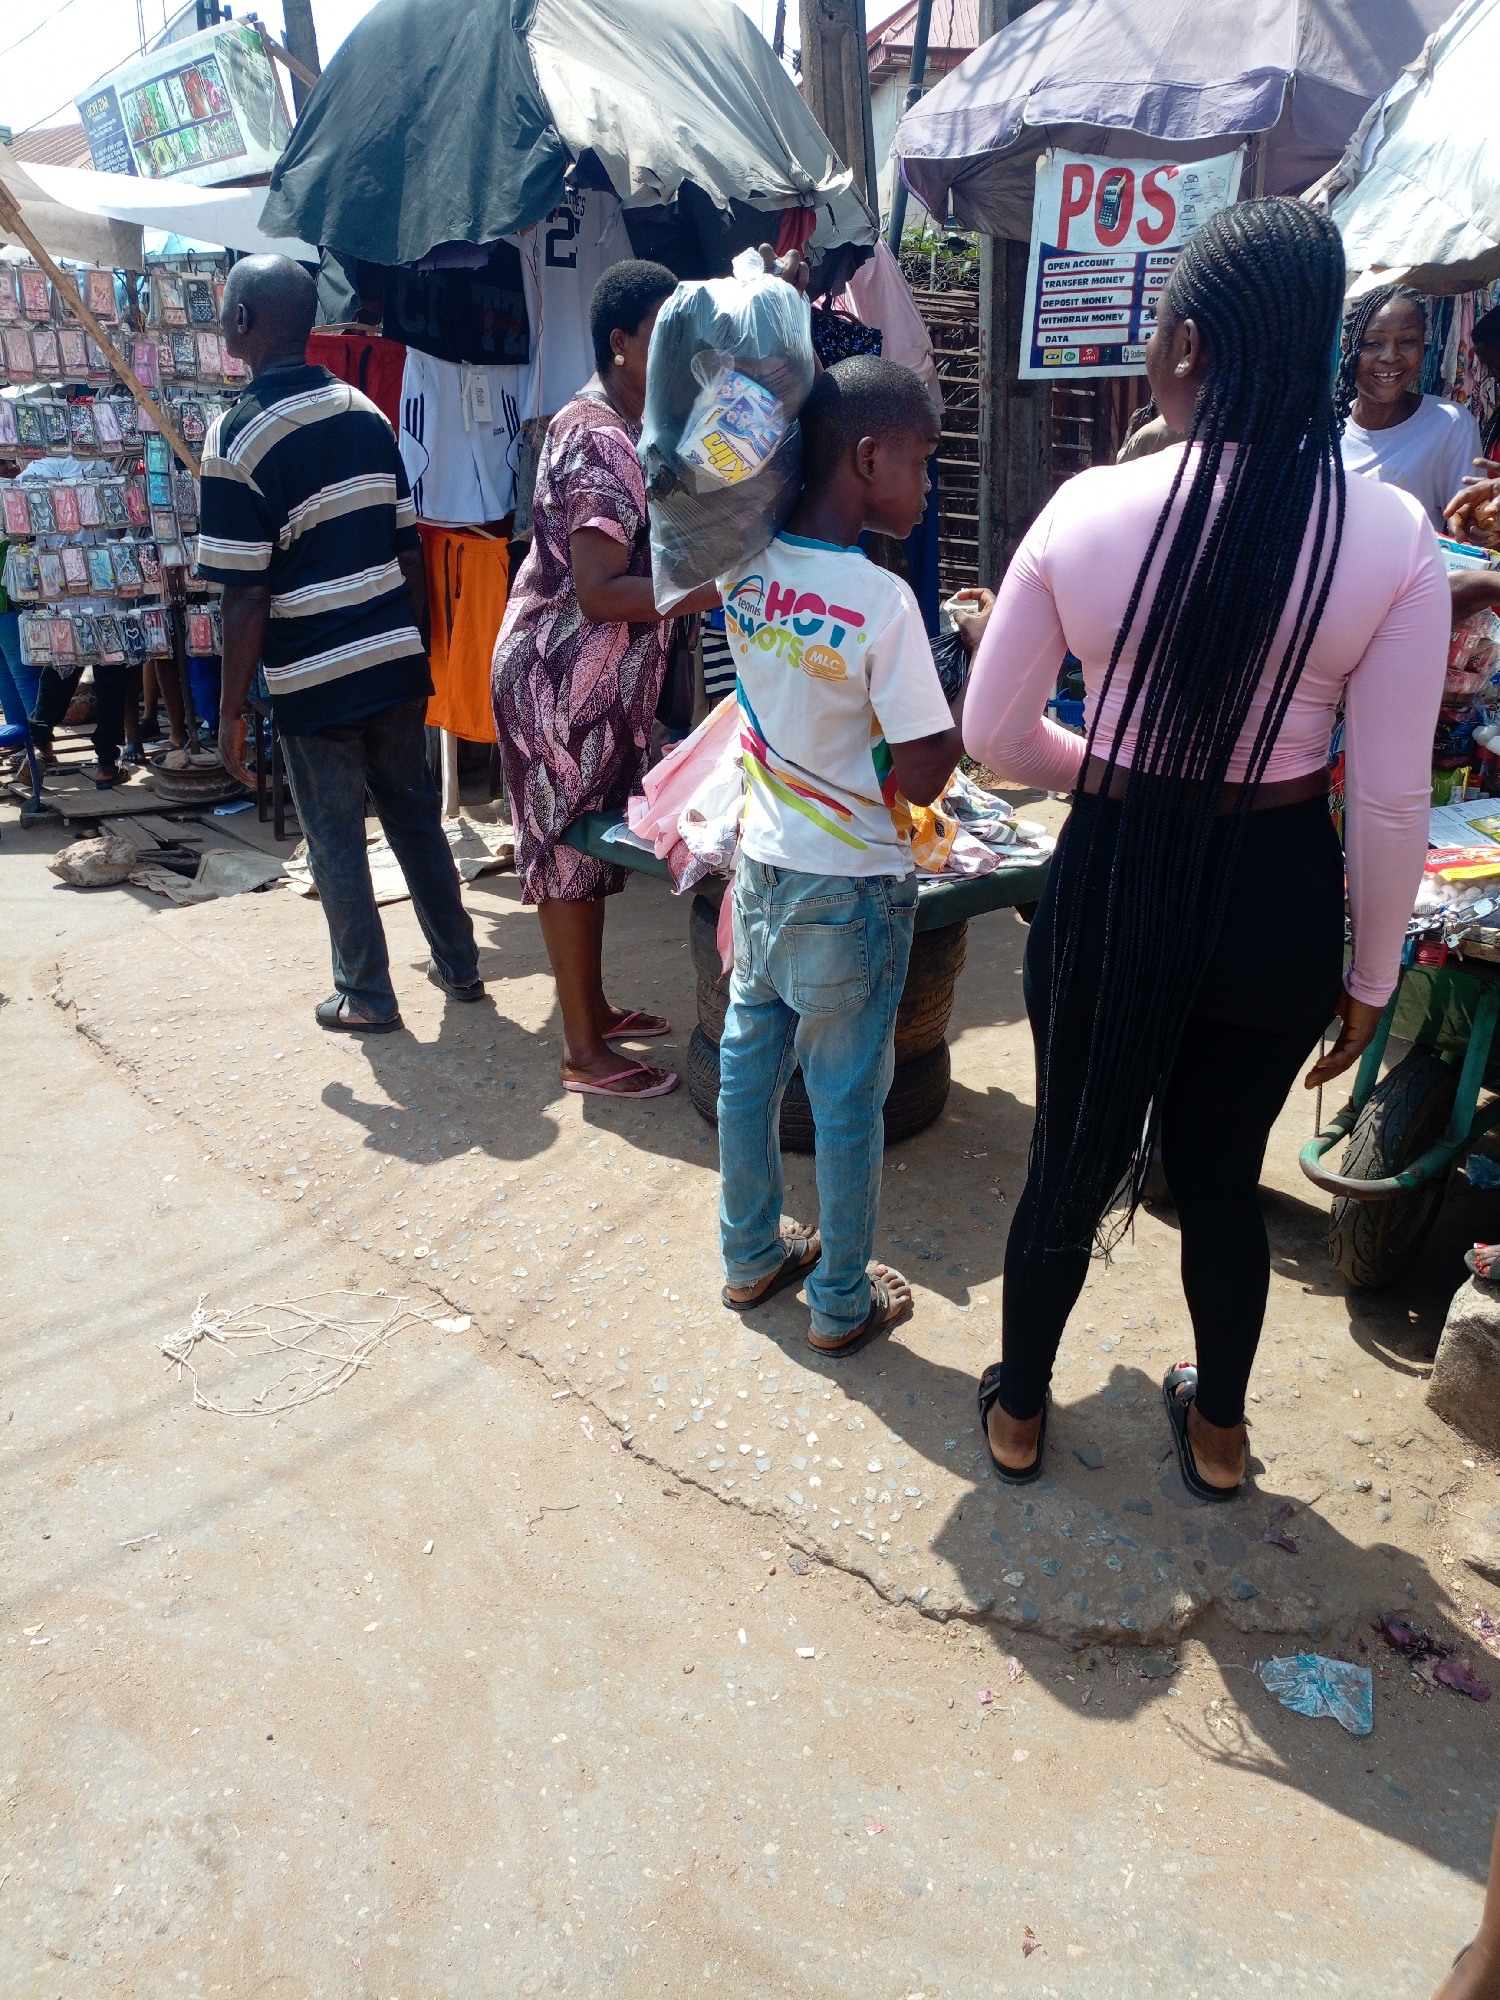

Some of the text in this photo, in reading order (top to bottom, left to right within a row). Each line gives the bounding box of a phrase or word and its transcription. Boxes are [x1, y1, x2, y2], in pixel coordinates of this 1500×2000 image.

[1057, 163, 1179, 250] POS
[1047, 258, 1115, 271] OPEN ACCOUNT
[1044, 275, 1126, 288] TRANSFER MONEY
[1042, 295, 1114, 308] DEPOSIT MONEY
[1041, 313, 1125, 325] WITHDRAW MONEY
[1045, 335, 1069, 343] DATA
[701, 430, 753, 485] Klin
[737, 596, 762, 617] tennis
[764, 581, 866, 649] HOT
[809, 650, 841, 671] MLC
